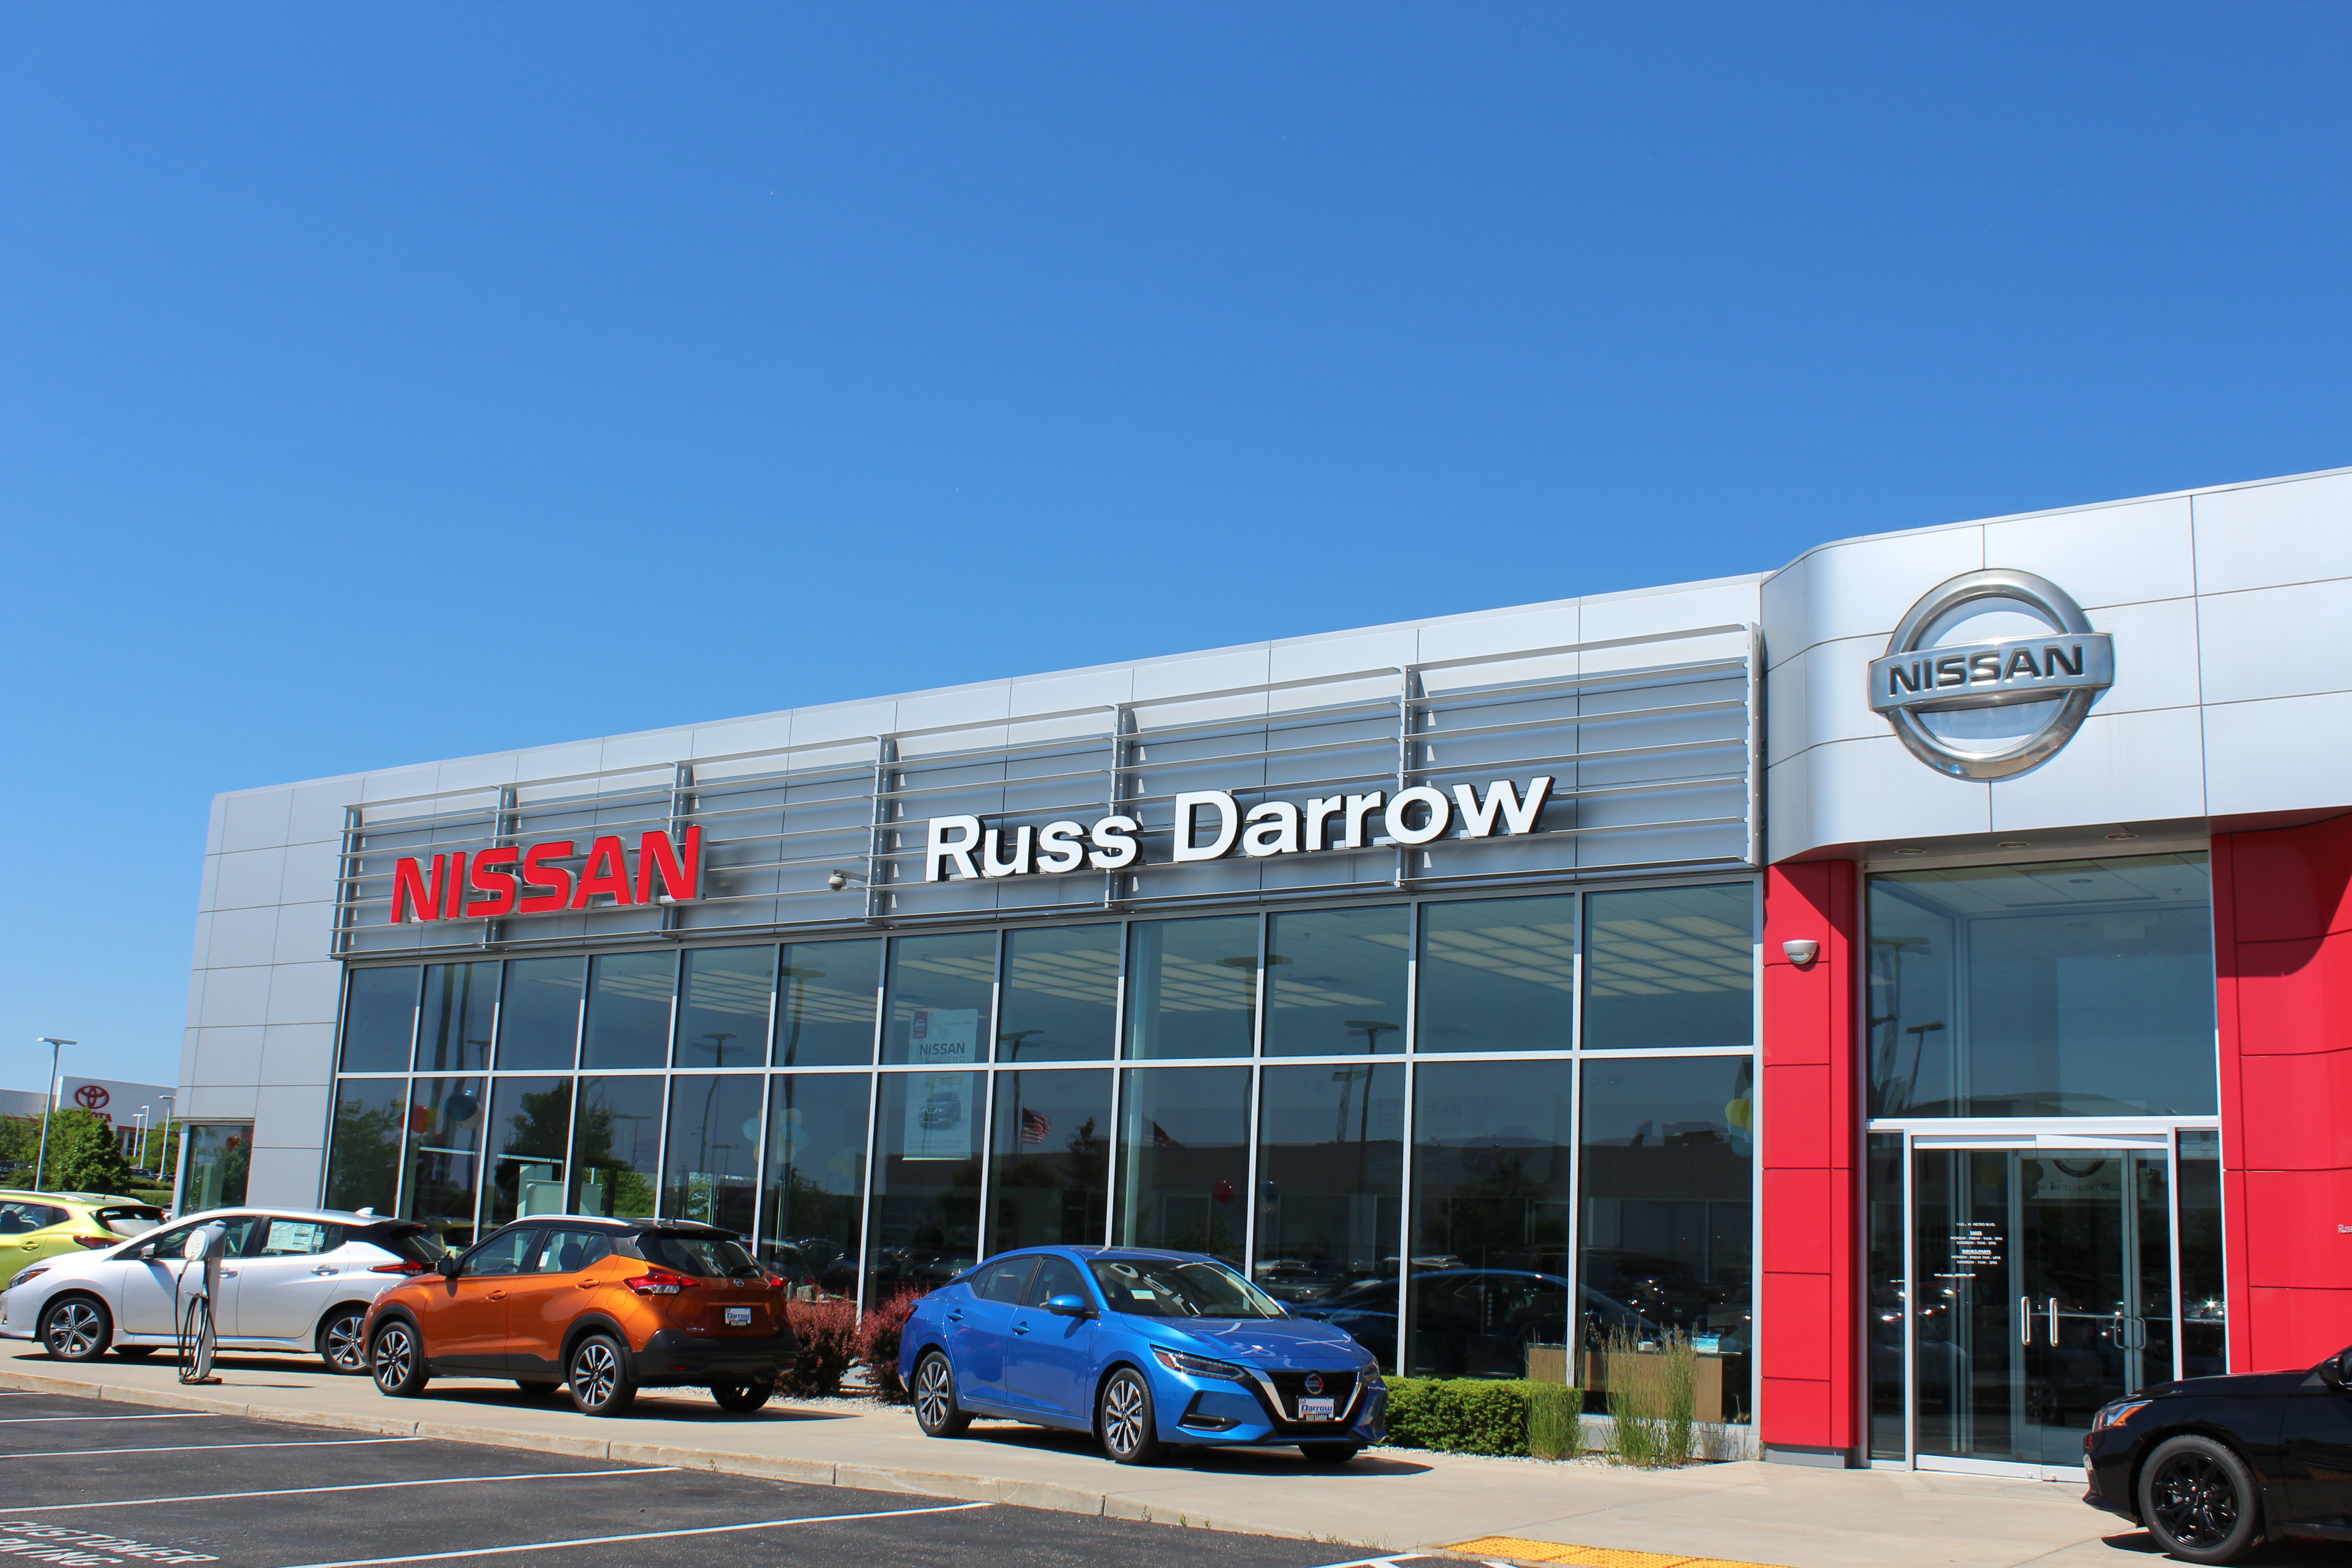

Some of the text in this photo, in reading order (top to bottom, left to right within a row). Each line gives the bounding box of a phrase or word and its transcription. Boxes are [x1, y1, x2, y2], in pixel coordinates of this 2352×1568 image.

[1888, 644, 2086, 697] NISSAN
[926, 775, 1555, 882] Russ Darrow
[390, 825, 706, 924] NISSAN
[920, 1043, 965, 1055] NISSAN
[1423, 1104, 1461, 1117] SSAN
